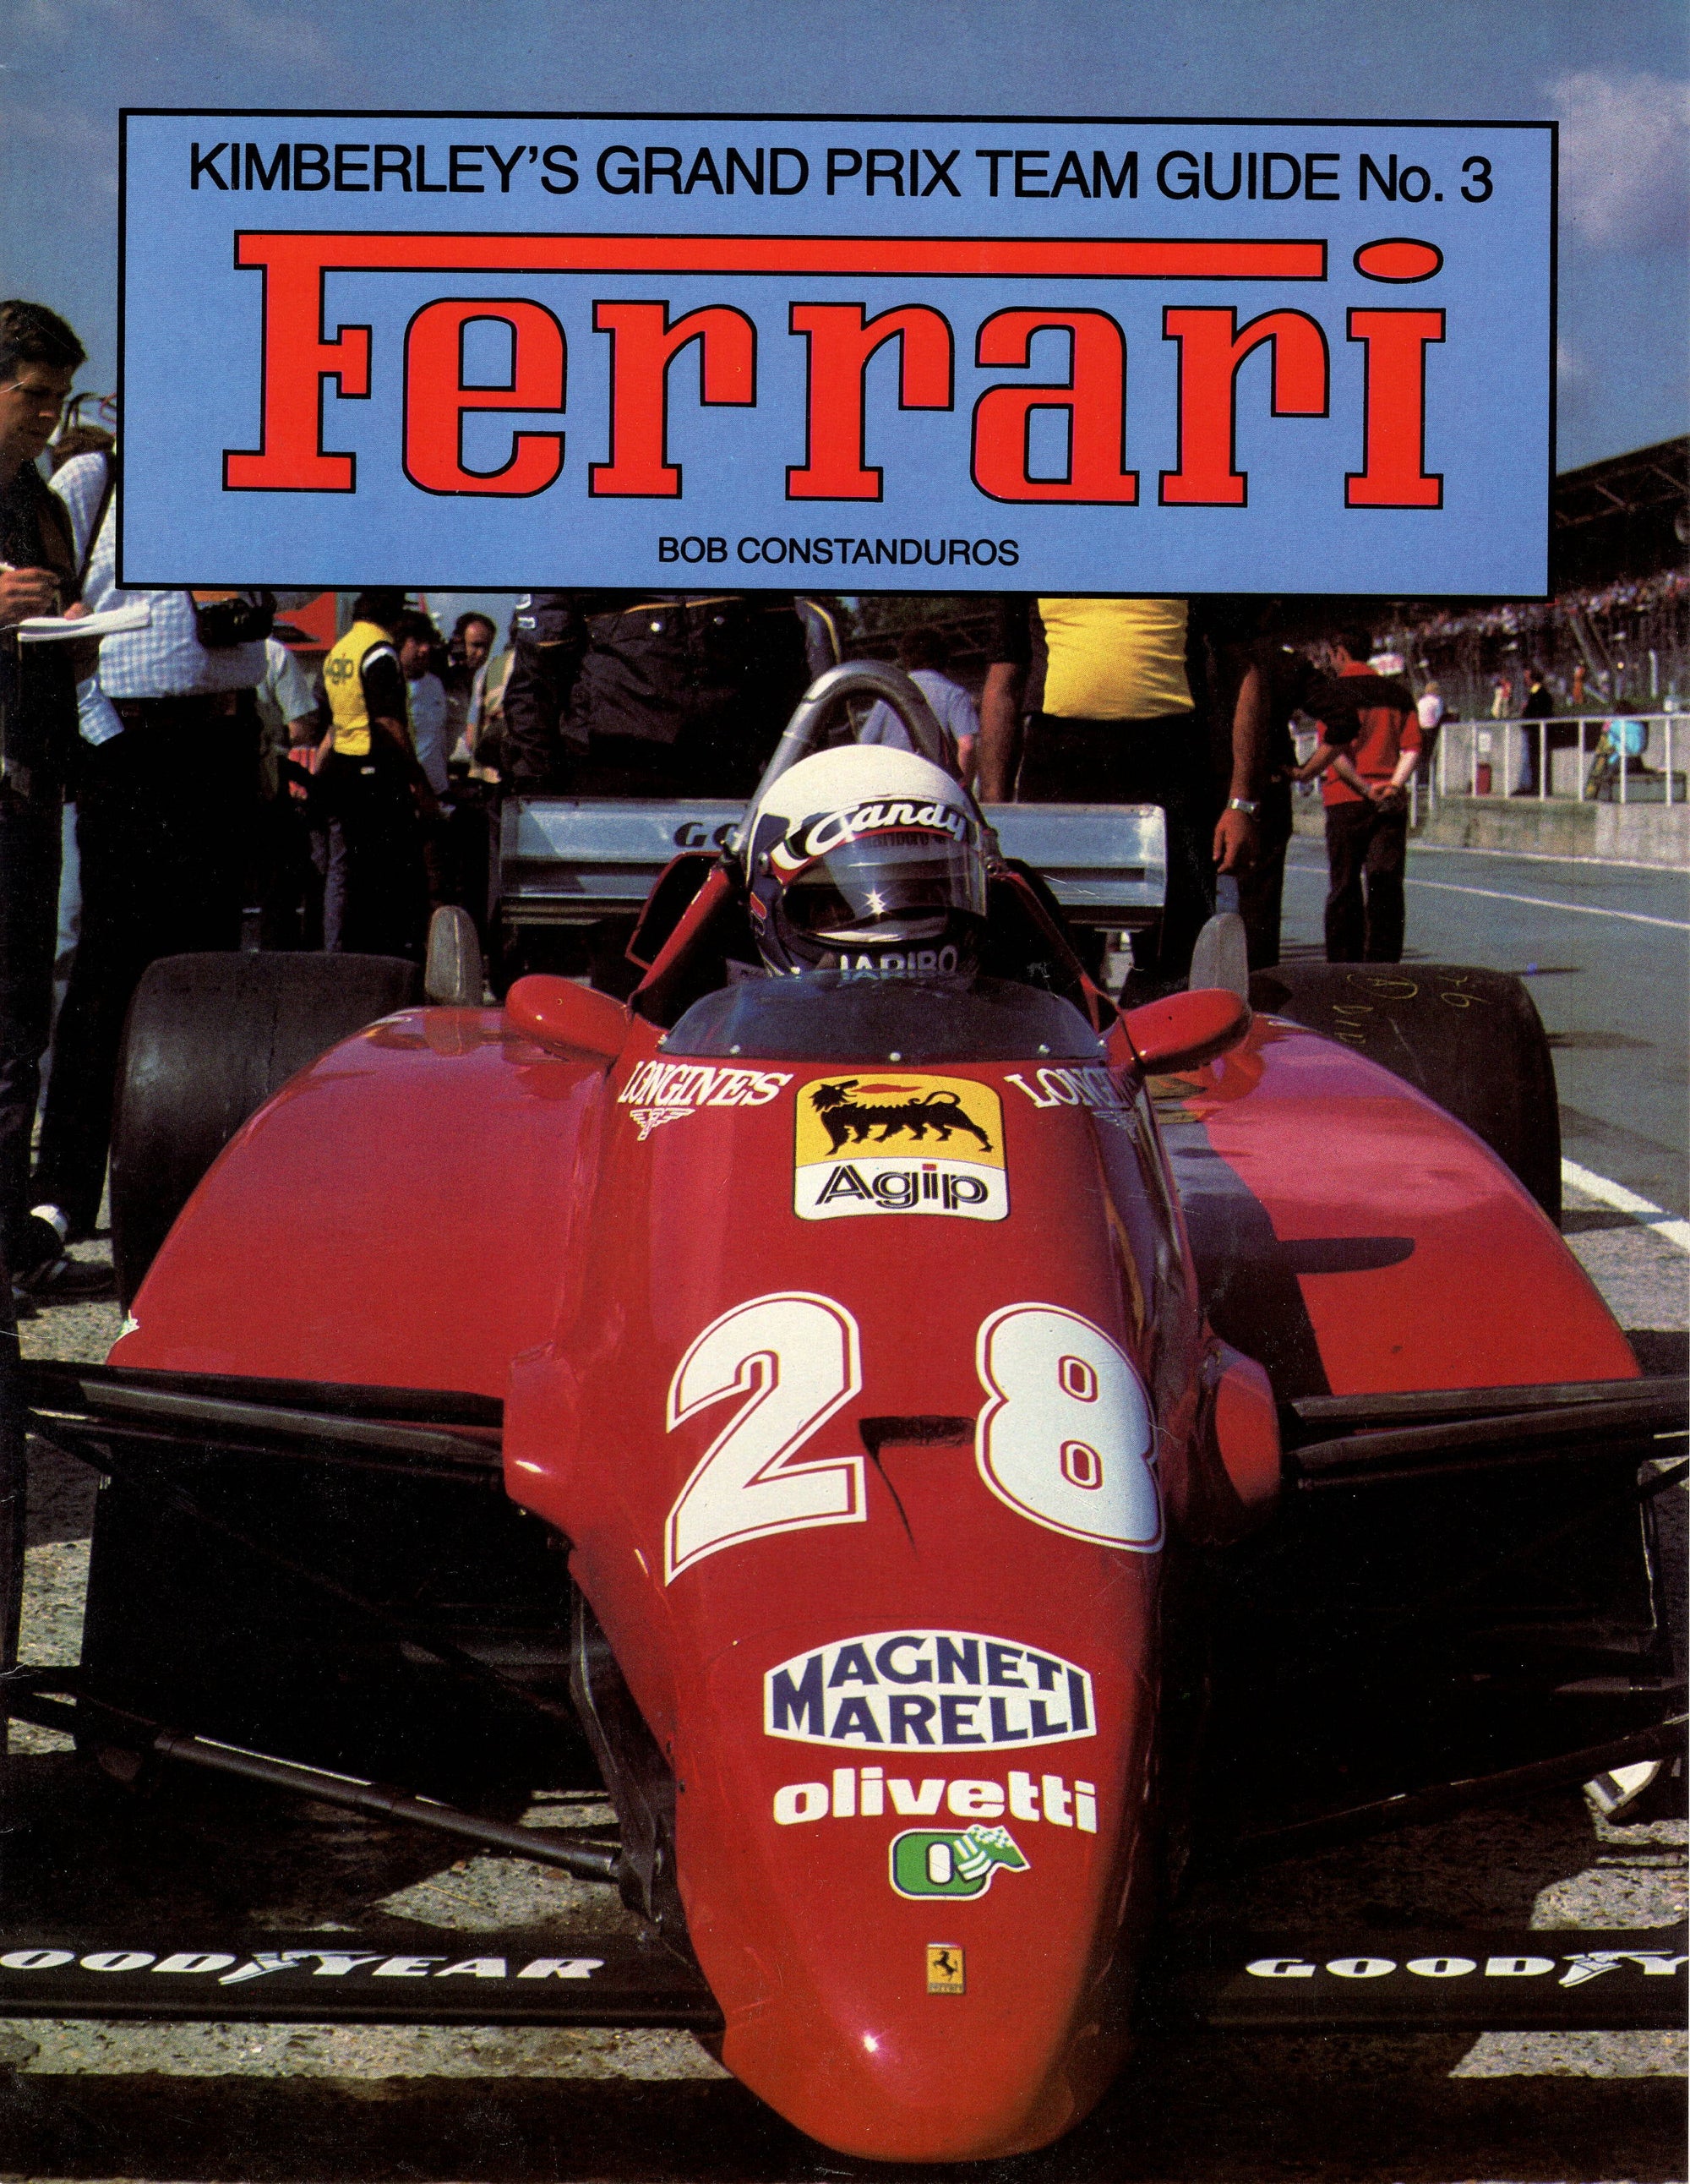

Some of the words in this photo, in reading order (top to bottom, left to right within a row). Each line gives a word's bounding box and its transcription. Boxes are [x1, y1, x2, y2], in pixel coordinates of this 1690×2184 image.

[804, 802, 967, 856] Candy
[617, 1061, 794, 1106] LONGINES
[815, 1163, 989, 1211] Agip
[772, 1636, 1088, 1692] MAGNETI
[772, 1692, 1088, 1744] MARELLI
[773, 1766, 1097, 1833] olivetti
